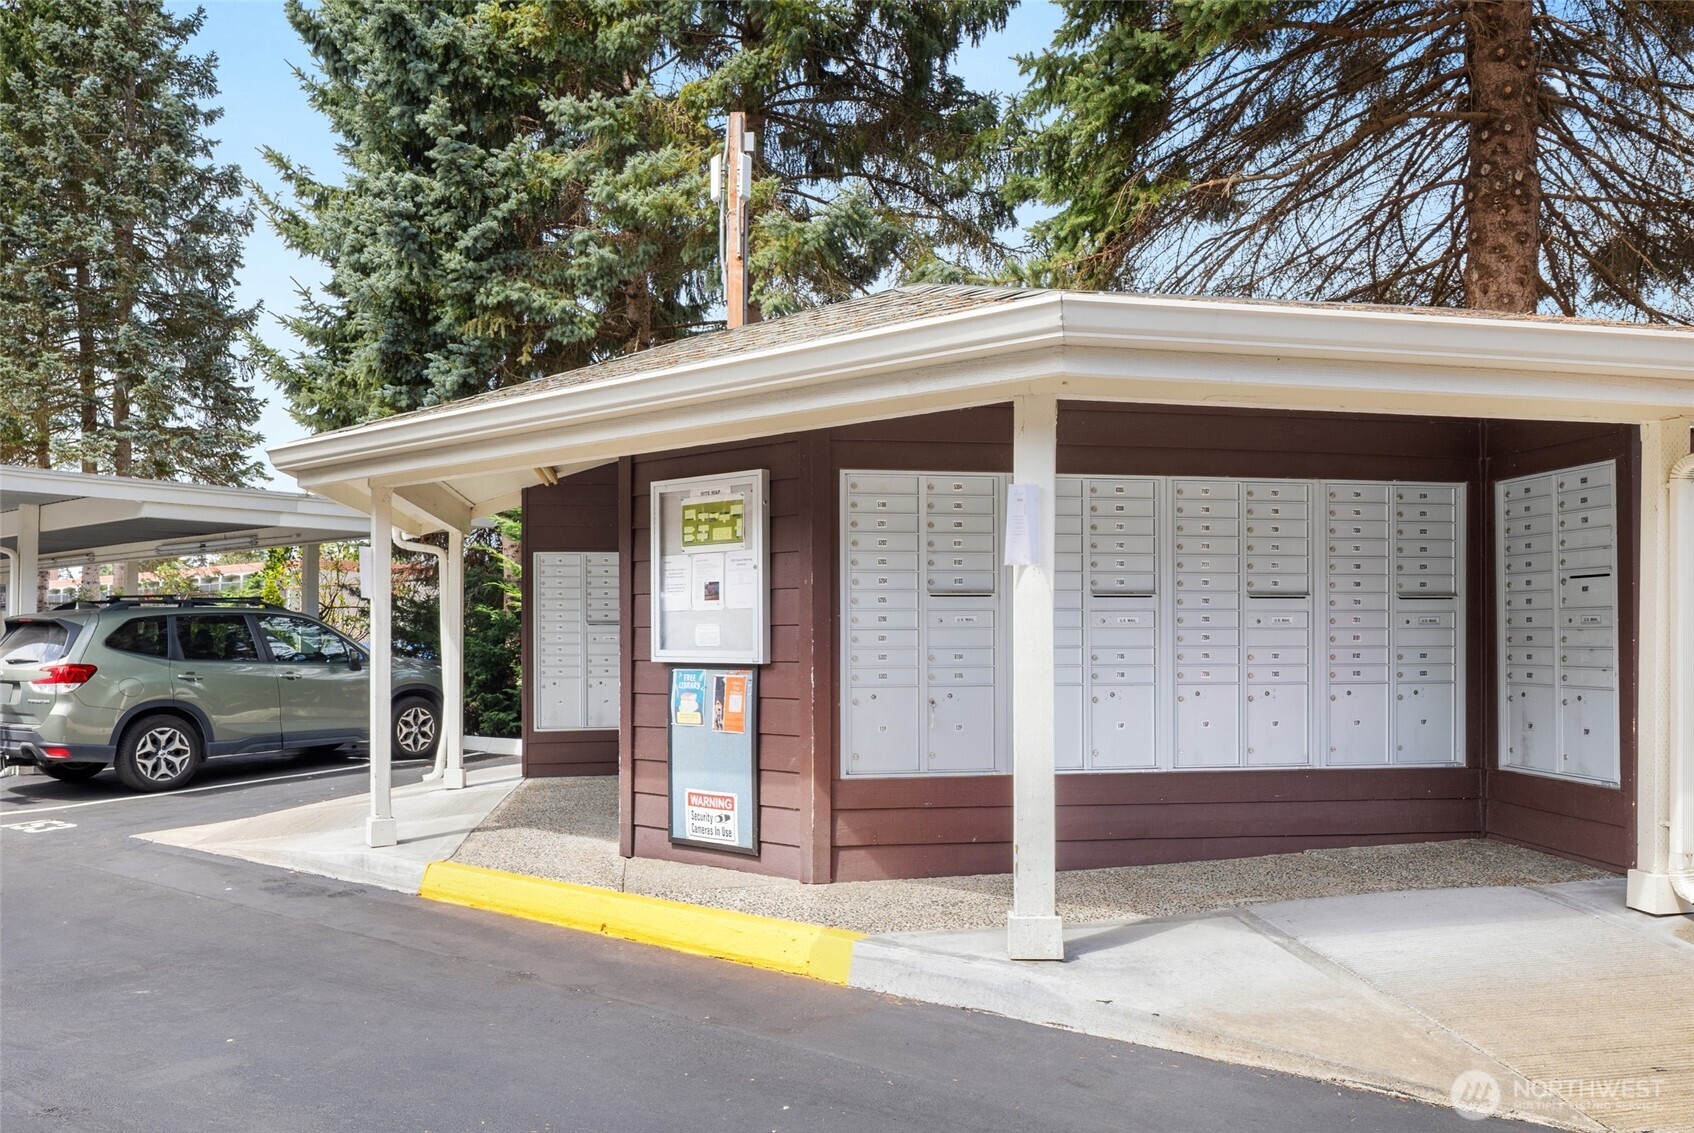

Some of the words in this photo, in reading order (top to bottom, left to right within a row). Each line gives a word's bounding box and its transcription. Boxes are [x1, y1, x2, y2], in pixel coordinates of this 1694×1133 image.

[679, 682, 700, 690] LIBRARY
[690, 794, 732, 809] WARNING
[691, 810, 713, 824] Security
[692, 823, 713, 836] Cameras
[715, 826, 720, 836] In
[722, 827, 732, 838] Use
